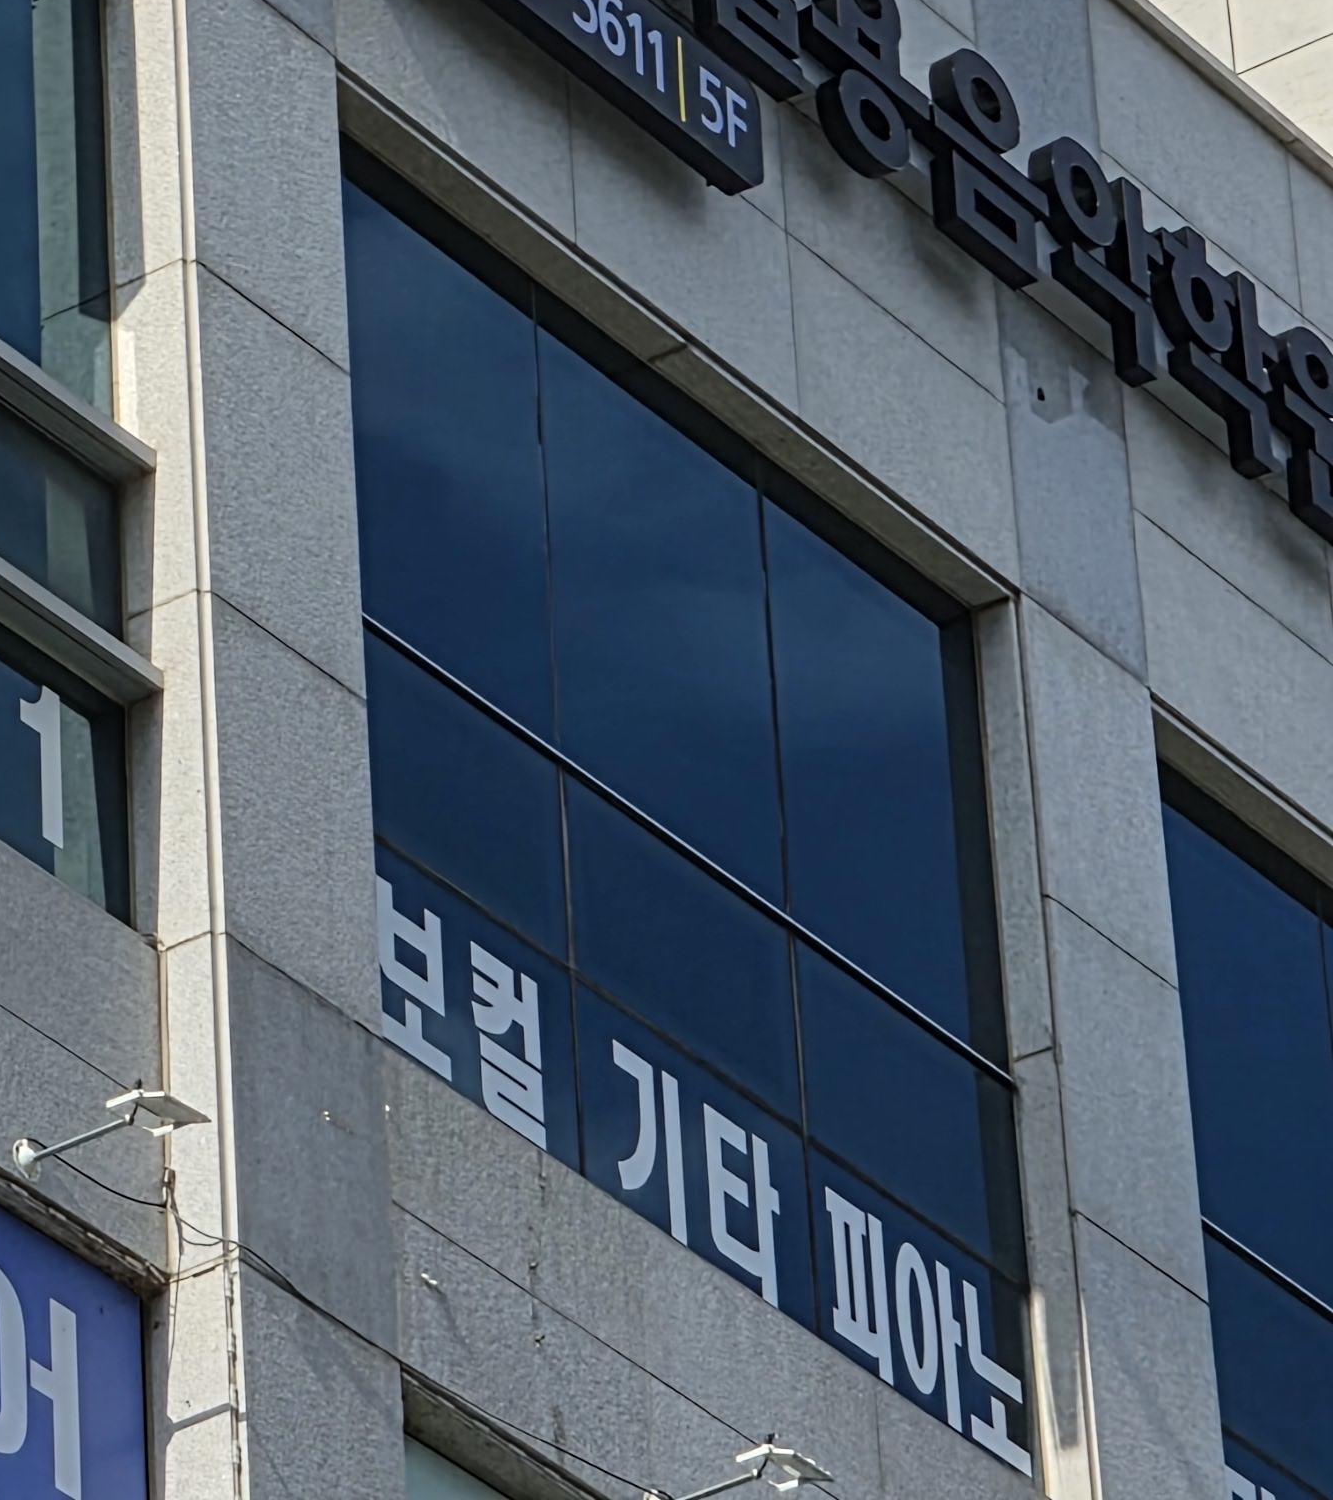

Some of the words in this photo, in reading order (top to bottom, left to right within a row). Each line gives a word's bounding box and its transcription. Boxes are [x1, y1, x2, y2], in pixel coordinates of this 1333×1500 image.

[699, 65, 749, 148] 5F
[376, 874, 548, 1151] 보컬
[612, 1038, 780, 1310] 기타
[824, 1185, 1034, 1479] 피아노
